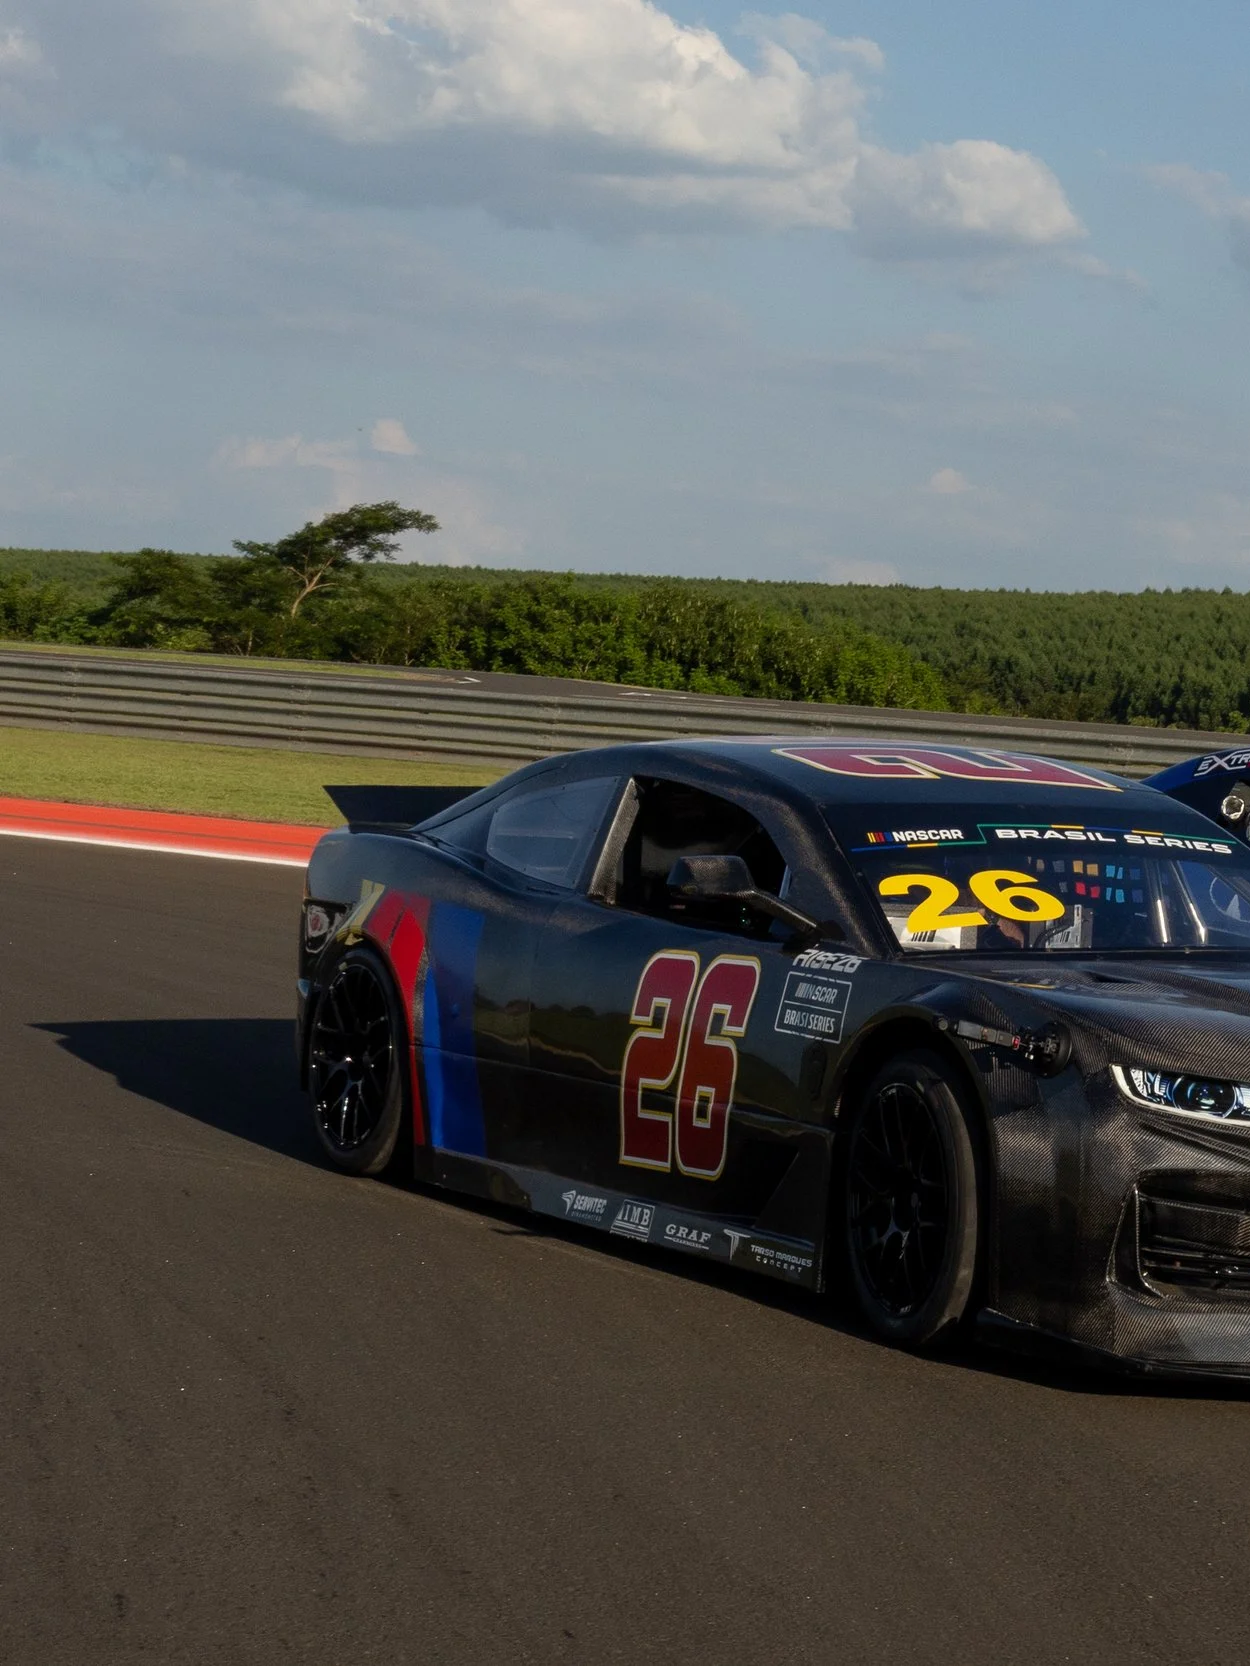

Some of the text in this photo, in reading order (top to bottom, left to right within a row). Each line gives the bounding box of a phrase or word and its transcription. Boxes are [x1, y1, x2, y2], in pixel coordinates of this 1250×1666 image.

[892, 828, 1232, 854] NASCAR BRASIL SERIES
[878, 870, 1065, 933] 26
[808, 1014, 836, 1033] SERIES
[619, 948, 761, 1181] 26
[665, 1223, 711, 1243] GRAF
[751, 1245, 813, 1267] TARSO MARQUES
